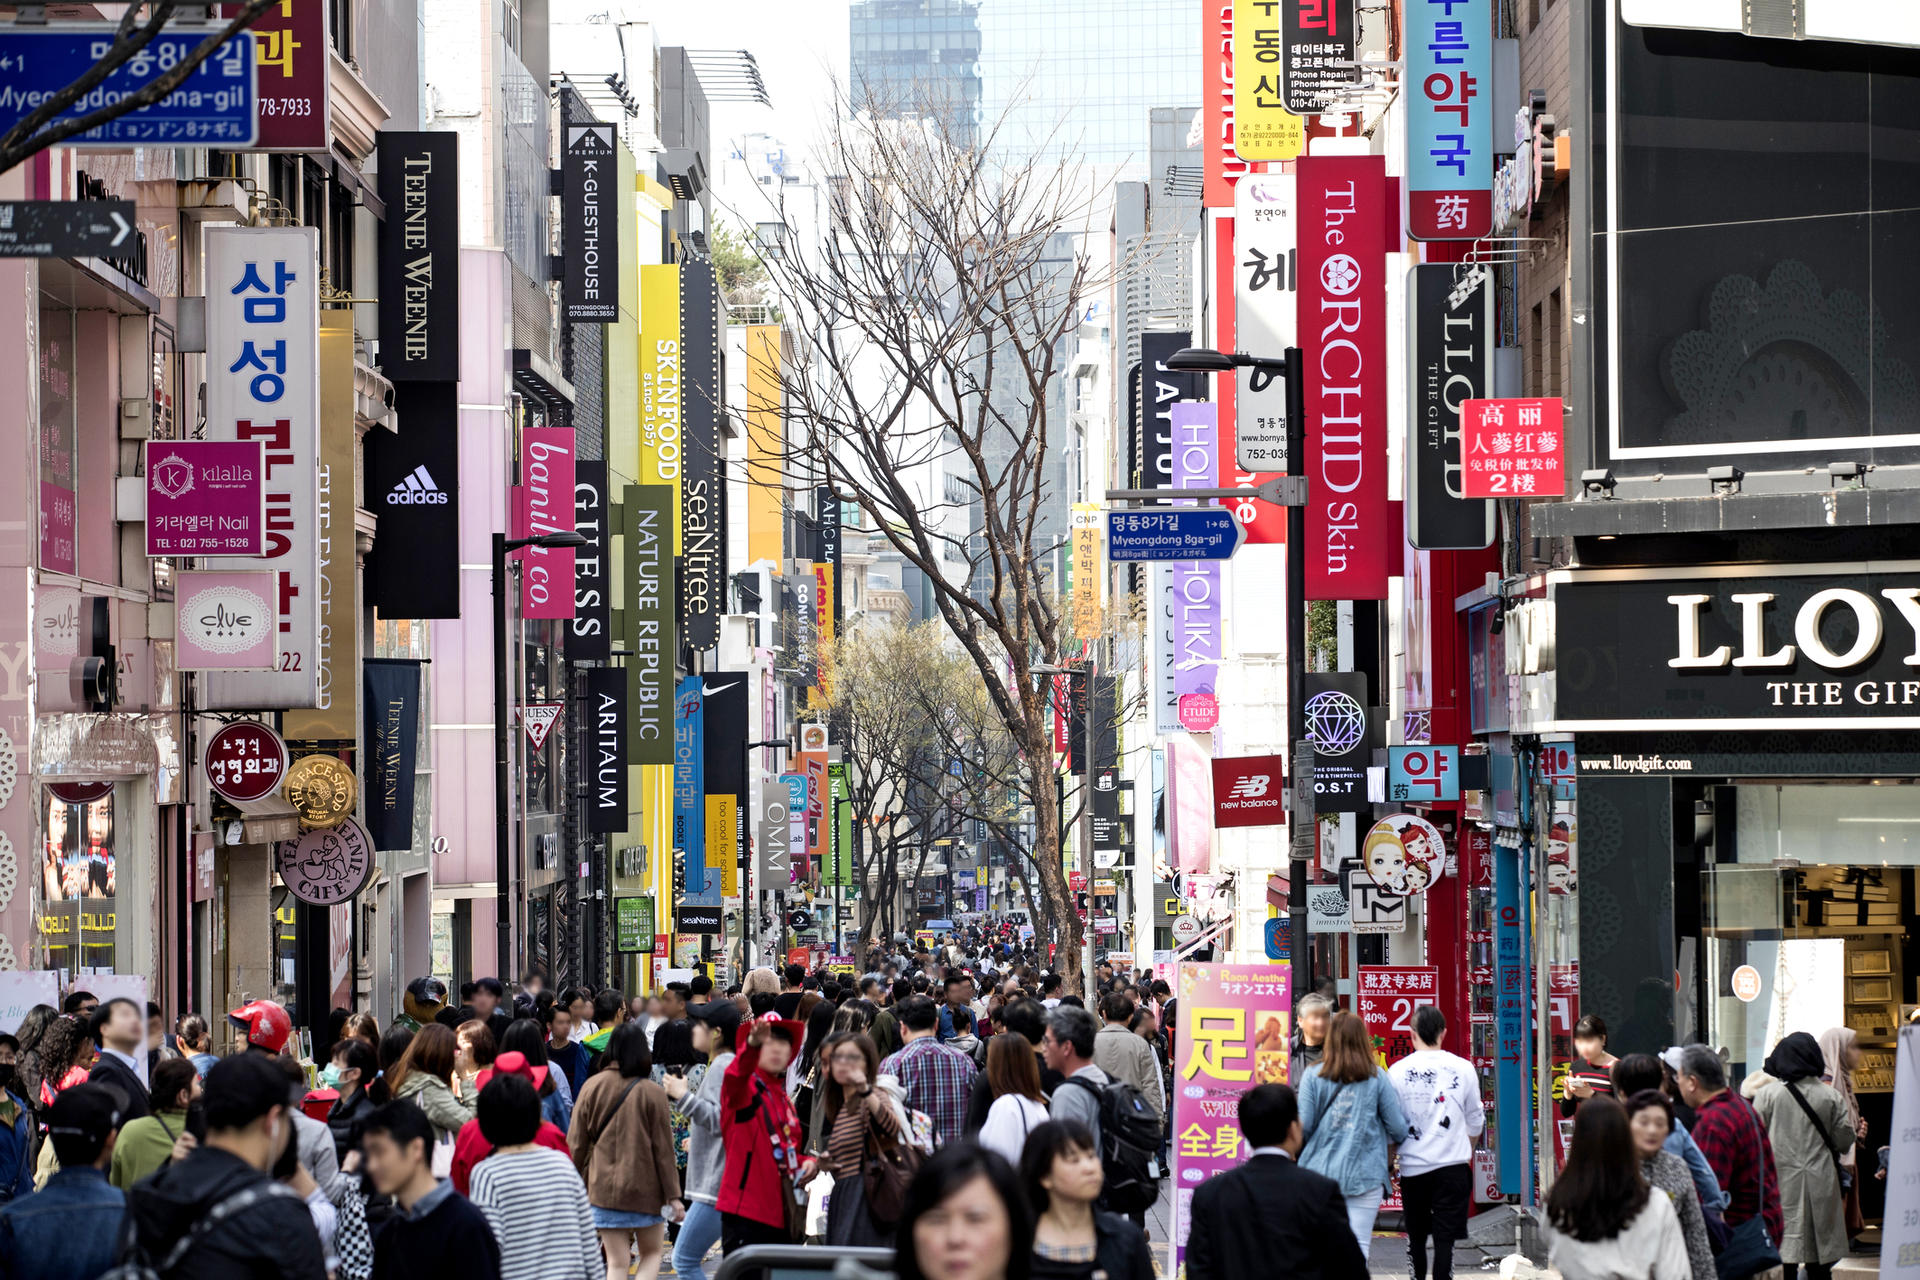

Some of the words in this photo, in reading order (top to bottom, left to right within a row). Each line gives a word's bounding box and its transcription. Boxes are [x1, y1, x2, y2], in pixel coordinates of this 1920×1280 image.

[404, 152, 431, 250] TEENIE
[1324, 181, 1356, 246] The
[1435, 195, 1469, 231] 药
[583, 160, 598, 300] K-GUESTHOUSE
[404, 252, 433, 361] WEENIE
[643, 372, 655, 412] since
[1428, 363, 1438, 401] THE
[656, 340, 679, 480] SKINFOOD
[643, 415, 656, 447] 1957
[1428, 405, 1439, 449] GIFT
[202, 465, 252, 481] kilalla
[386, 489, 448, 505] adidas
[155, 515, 214, 531] 키라엘라
[219, 516, 249, 530] Nail
[1076, 515, 1098, 524] CNP
[1112, 514, 1180, 532] 명동8가길
[1219, 520, 1230, 528] 66
[156, 538, 171, 548] TEL
[201, 538, 249, 548] 755-1526
[1112, 534, 1182, 547] Myeongdong
[1184, 533, 1222, 546] 8ga-gil
[1327, 502, 1358, 575] Skin
[573, 482, 601, 638] GUESS
[638, 509, 659, 610] NATURE
[529, 566, 550, 609] co.
[797, 583, 808, 664] CONVERSE
[638, 620, 660, 741] REPUBLIC
[1767, 682, 1842, 705] THE
[387, 697, 404, 750] TEENIE
[1183, 707, 1215, 718] ETUDE
[598, 692, 618, 809] ARITAUM
[1580, 754, 1692, 772] www.lloydgift.com
[211, 757, 279, 786] 성형외과
[385, 753, 401, 811] WEENIE
[1314, 782, 1354, 793] O.S.T
[1403, 751, 1449, 798] 약
[719, 801, 728, 817] too
[1221, 801, 1239, 809] new
[1241, 799, 1279, 809] balance
[719, 819, 728, 840] cool
[719, 843, 728, 857] for
[297, 880, 347, 900] CAFE
[719, 858, 728, 891] school
[1220, 982, 1287, 997] ラオンエステ
[1365, 973, 1434, 989] 批发专卖店
[1365, 1013, 1388, 1024] 40%
[1181, 1007, 1254, 1082] 足
[1179, 1122, 1244, 1159] 全身
